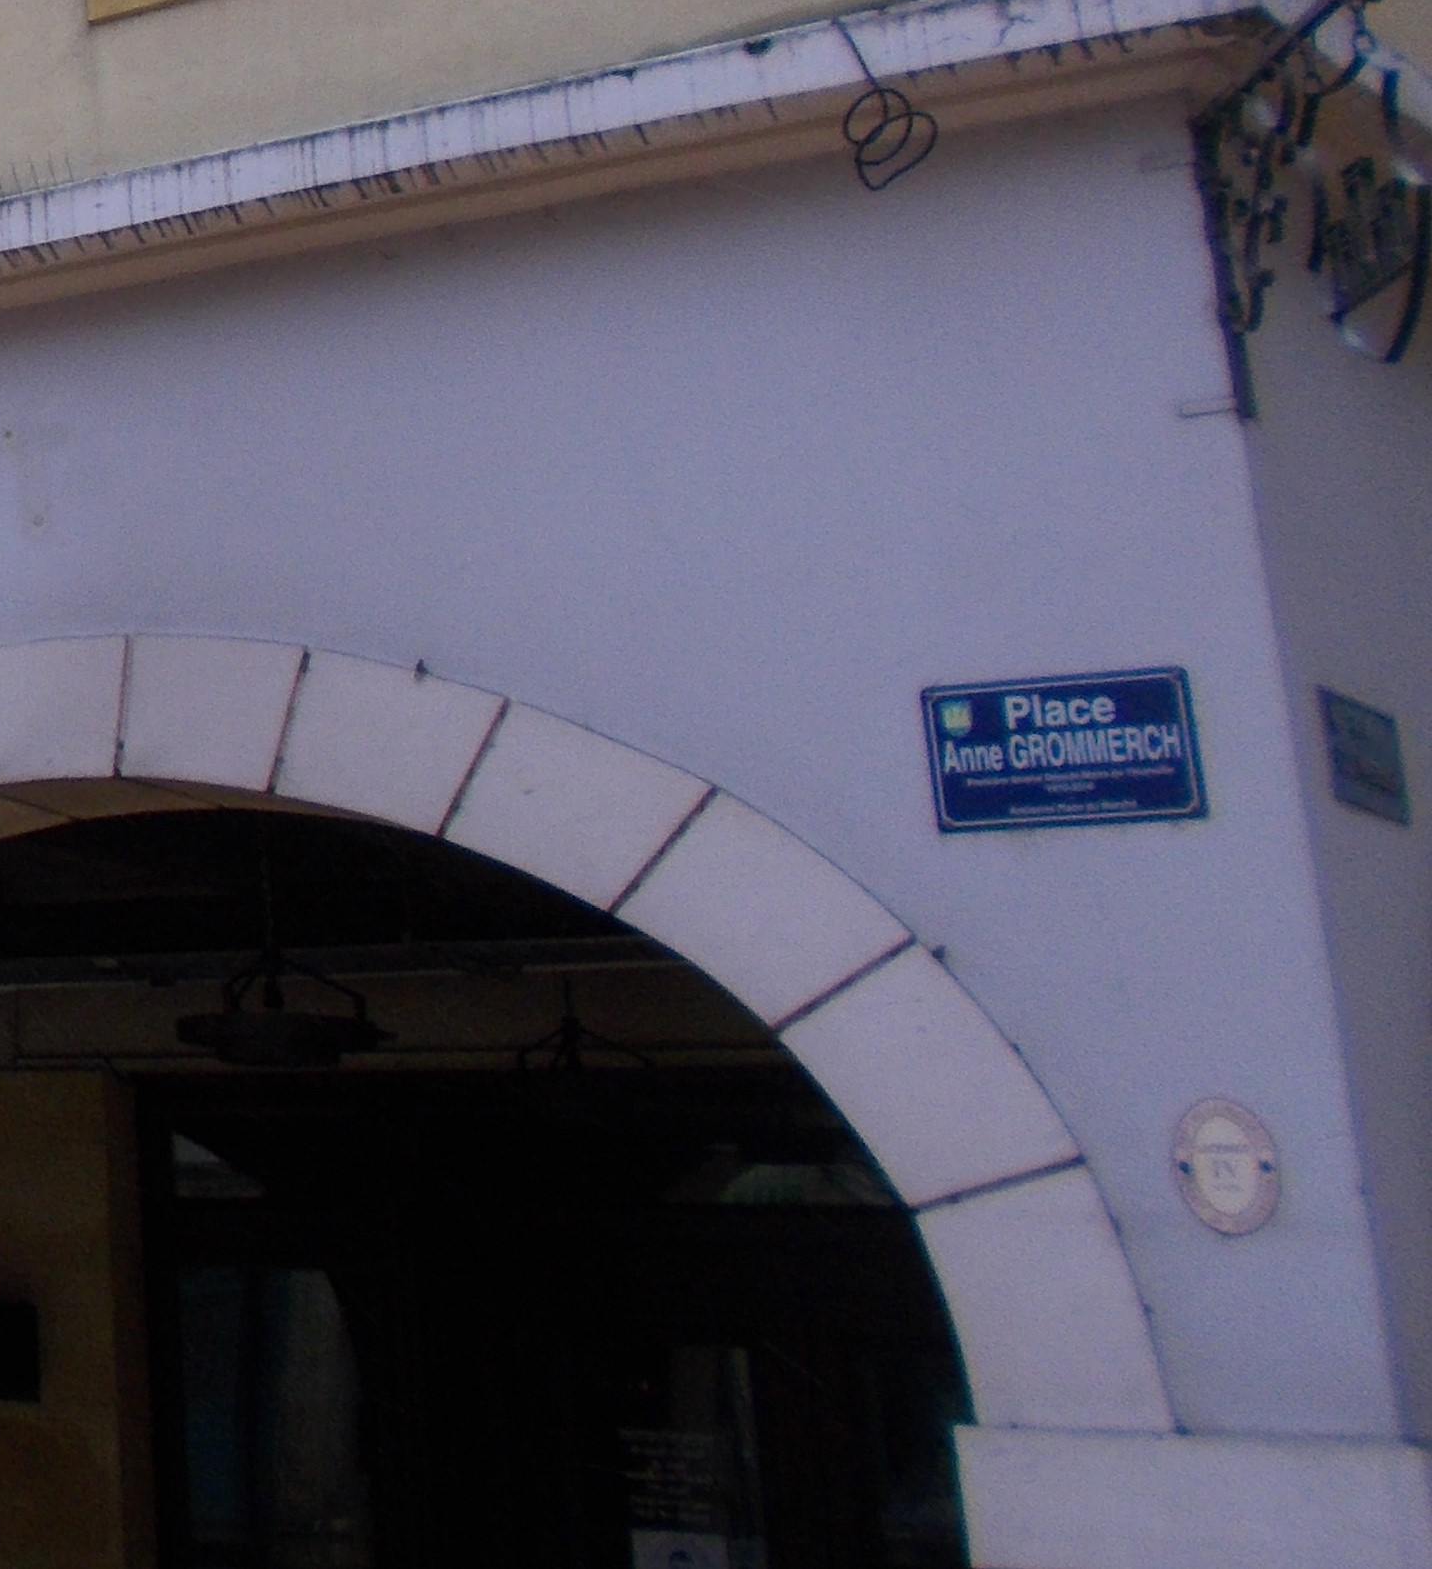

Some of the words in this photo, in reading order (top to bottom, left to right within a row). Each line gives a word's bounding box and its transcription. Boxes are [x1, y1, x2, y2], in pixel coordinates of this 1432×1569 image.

[1005, 694, 1117, 731] Place
[943, 739, 1004, 774] Anne
[1009, 725, 1182, 769] GROMMERCH
